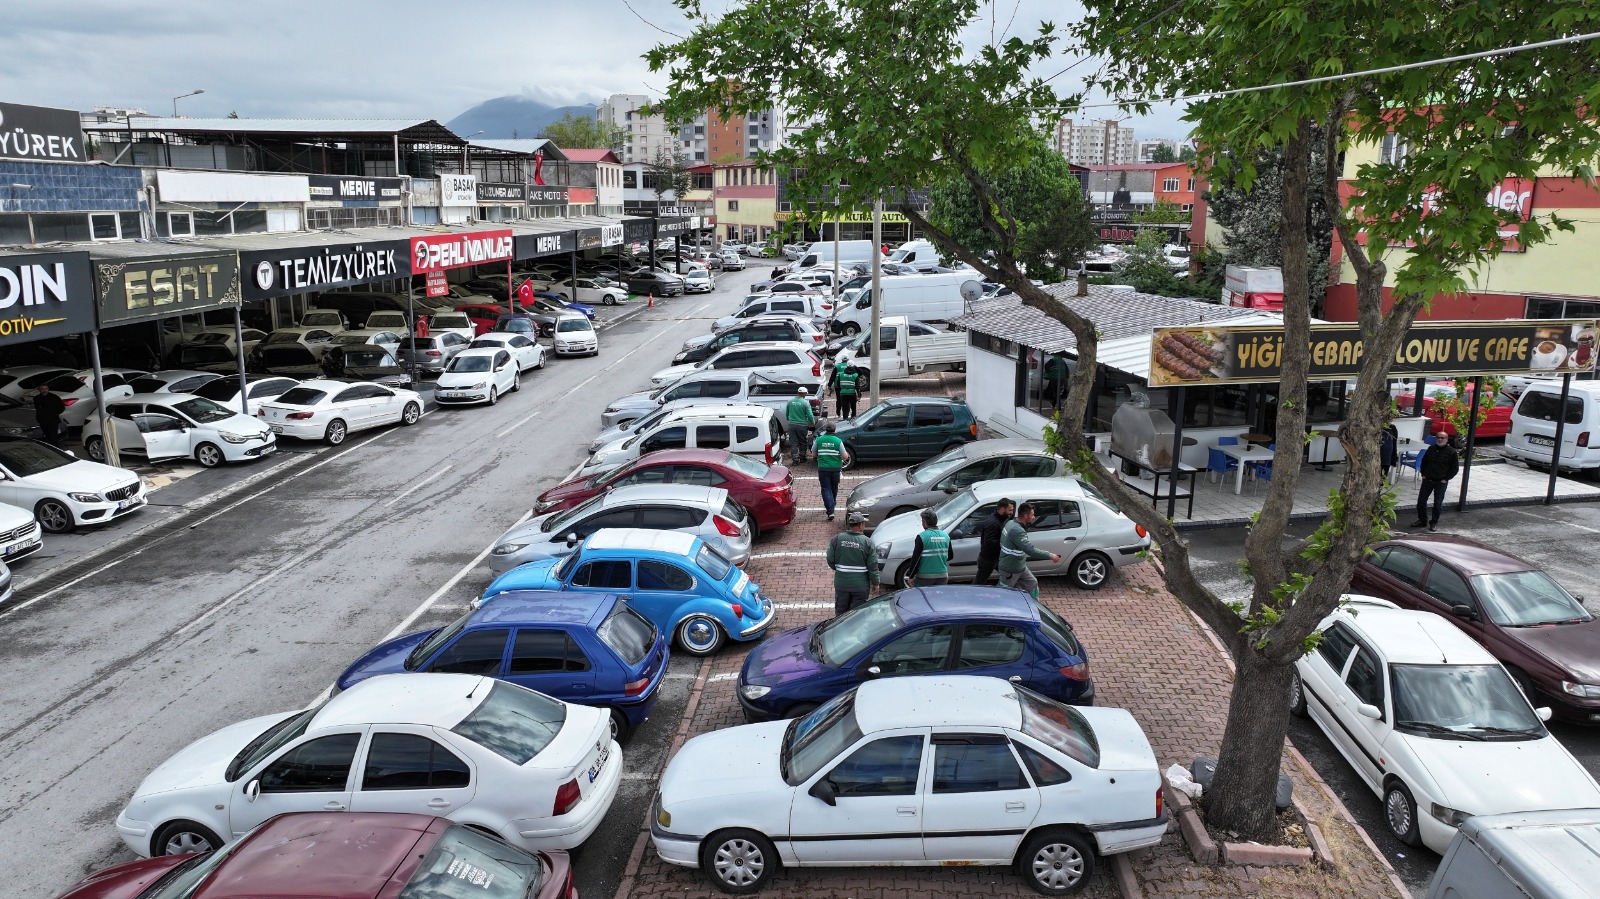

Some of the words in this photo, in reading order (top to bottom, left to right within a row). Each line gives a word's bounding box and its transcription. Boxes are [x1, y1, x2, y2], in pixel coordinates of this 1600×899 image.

[0, 127, 78, 158] YÜREK
[339, 180, 376, 196] MERVE
[453, 178, 475, 193] BAŞAK
[529, 190, 543, 200] AKE
[845, 213, 874, 221] MURA
[881, 213, 906, 221] AUTO
[428, 235, 513, 269] PEHLİVANLAR
[536, 235, 561, 253] MERVE
[279, 245, 397, 290] TEMİZYÜREK
[124, 263, 219, 310] ESAT
[1237, 335, 1285, 369] YİĞİ
[1308, 340, 1364, 366] EBAP
[1395, 338, 1452, 364] LONU
[1456, 338, 1480, 362] VE
[1484, 337, 1529, 362] CAFE
